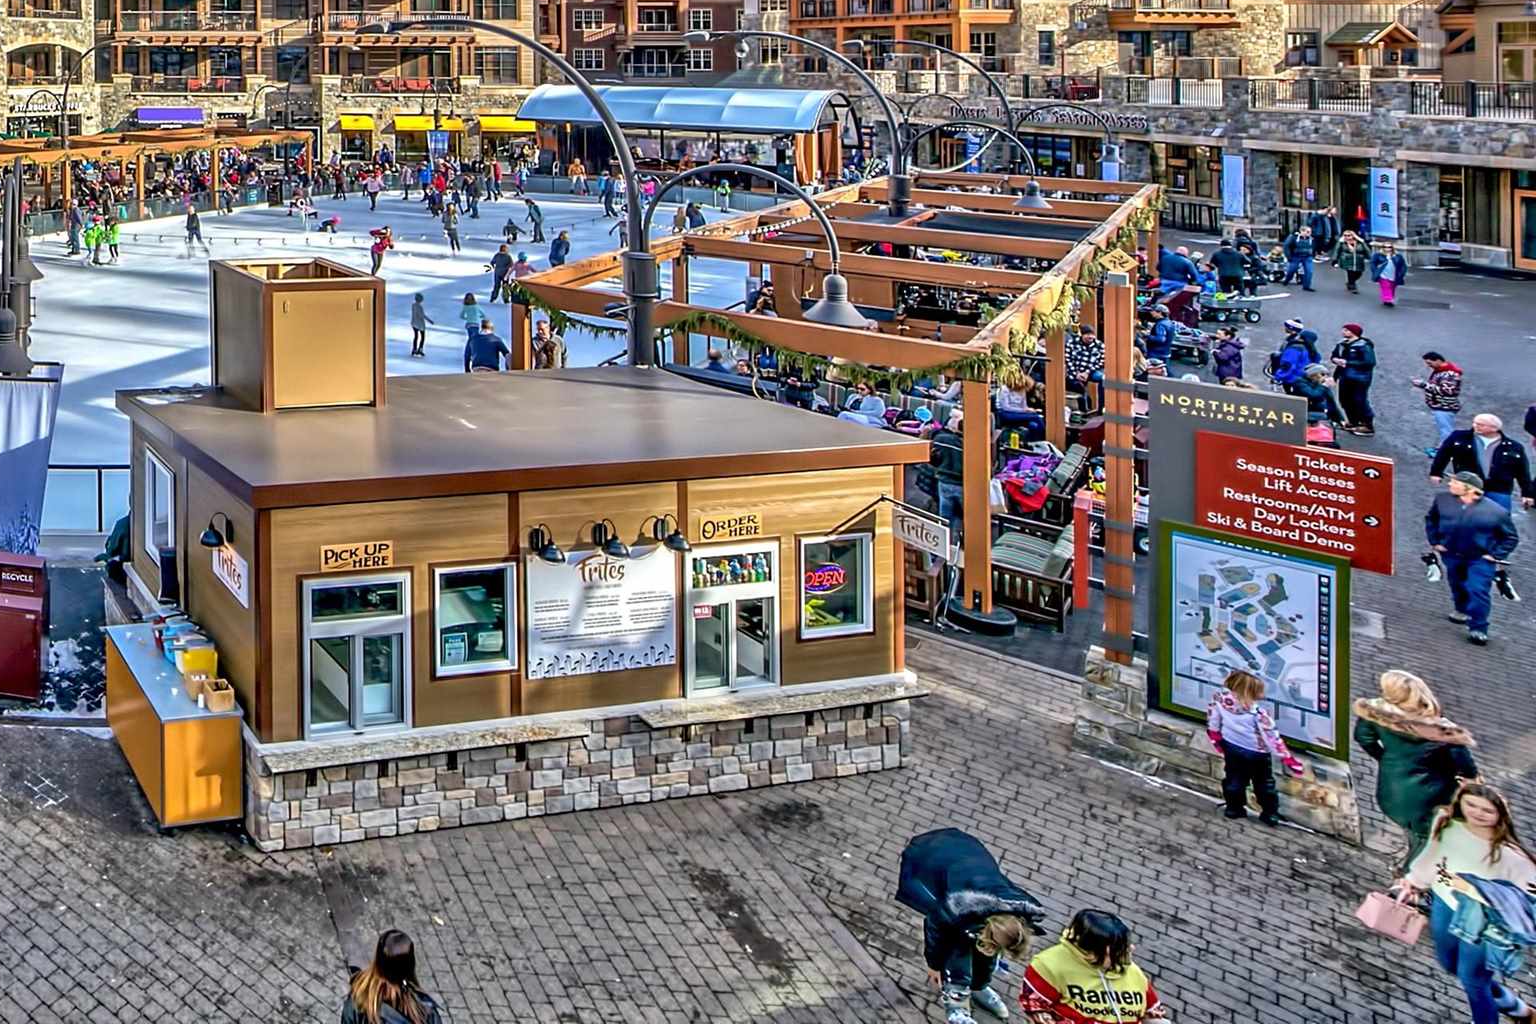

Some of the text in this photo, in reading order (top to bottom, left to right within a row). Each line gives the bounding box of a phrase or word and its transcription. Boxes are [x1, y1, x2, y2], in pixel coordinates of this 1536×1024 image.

[1160, 393, 1295, 425] NORTHSTAR
[1181, 407, 1276, 428] CALIFORNIA
[1236, 458, 1356, 489] Season Passes
[1294, 453, 1356, 475] Tickets
[1264, 477, 1356, 504] Lift Access
[1223, 487, 1355, 523] Restrooms/ATM
[702, 514, 759, 540] ORDER
[728, 525, 760, 537] HERE
[896, 514, 940, 548] Frites
[1207, 512, 1231, 526] Ski
[1234, 519, 1247, 530] &
[1251, 521, 1300, 541] Board
[1304, 532, 1355, 552] Demo
[1254, 507, 1356, 538] Day Lockers
[324, 543, 390, 565] PICK UP
[352, 555, 389, 569] HERE
[1, 572, 33, 583] RECYCLE
[575, 553, 625, 583] Frites
[805, 567, 846, 587] OPEN
[1067, 984, 1143, 1005] Ramen
